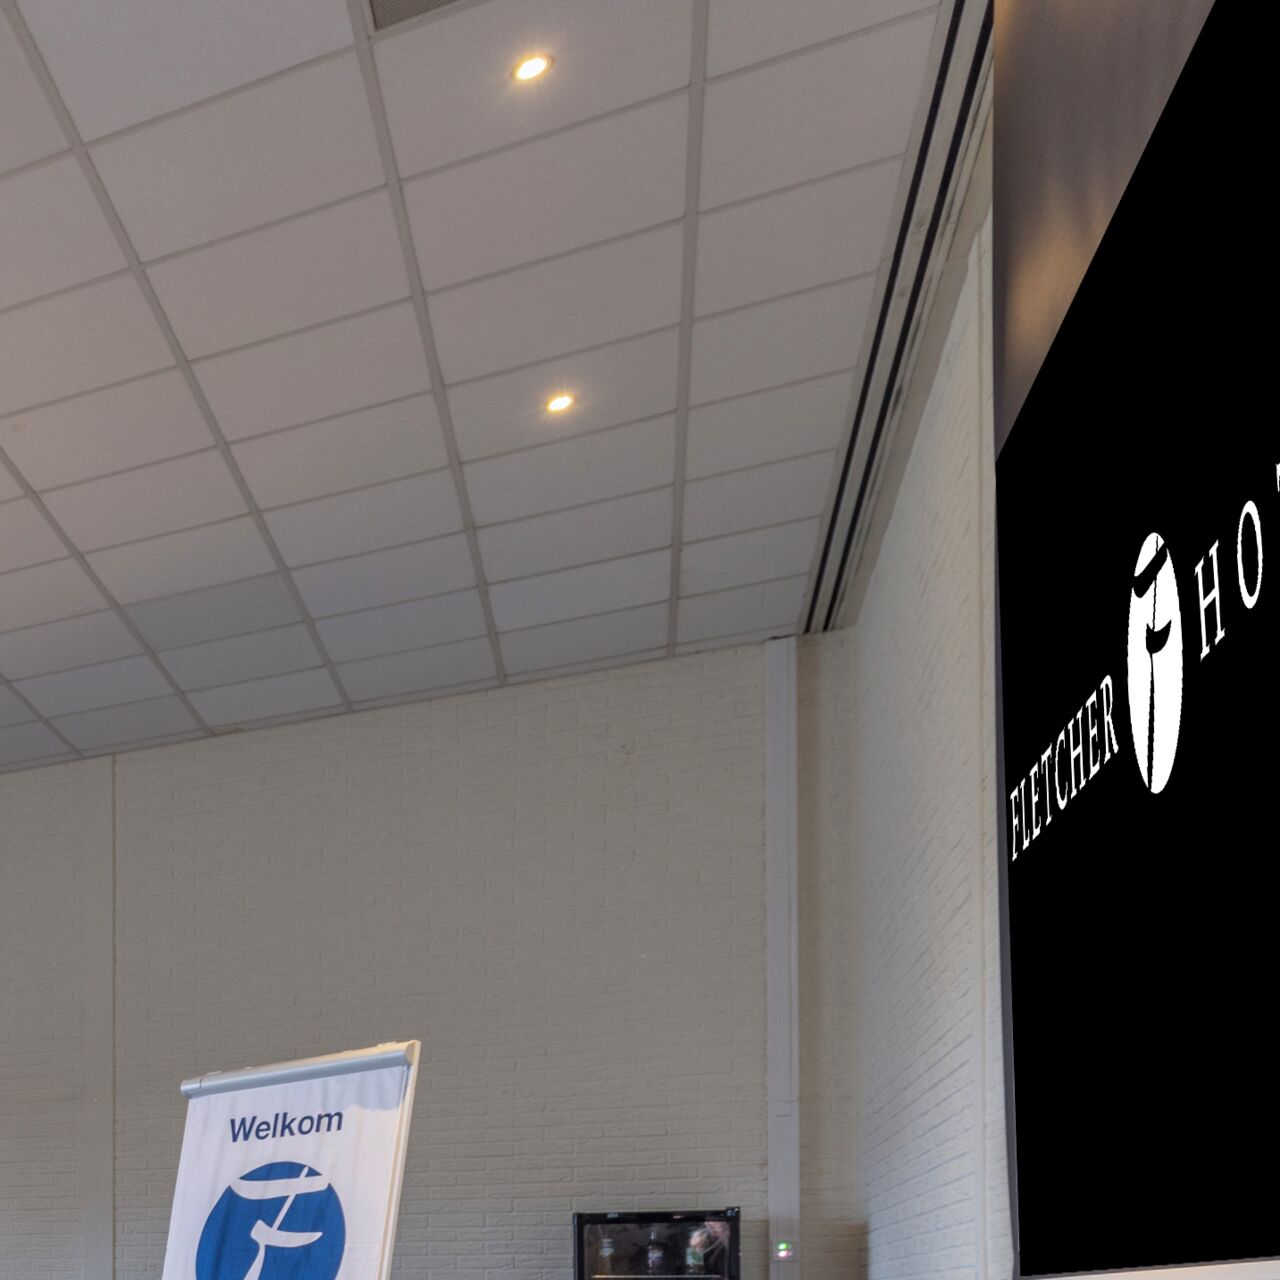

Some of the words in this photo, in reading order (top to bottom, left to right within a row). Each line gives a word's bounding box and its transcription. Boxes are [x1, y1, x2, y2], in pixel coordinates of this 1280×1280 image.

[1009, 674, 1119, 862] FLETCHER
[1194, 462, 1280, 661] HO
[229, 1111, 343, 1143] Welkom
